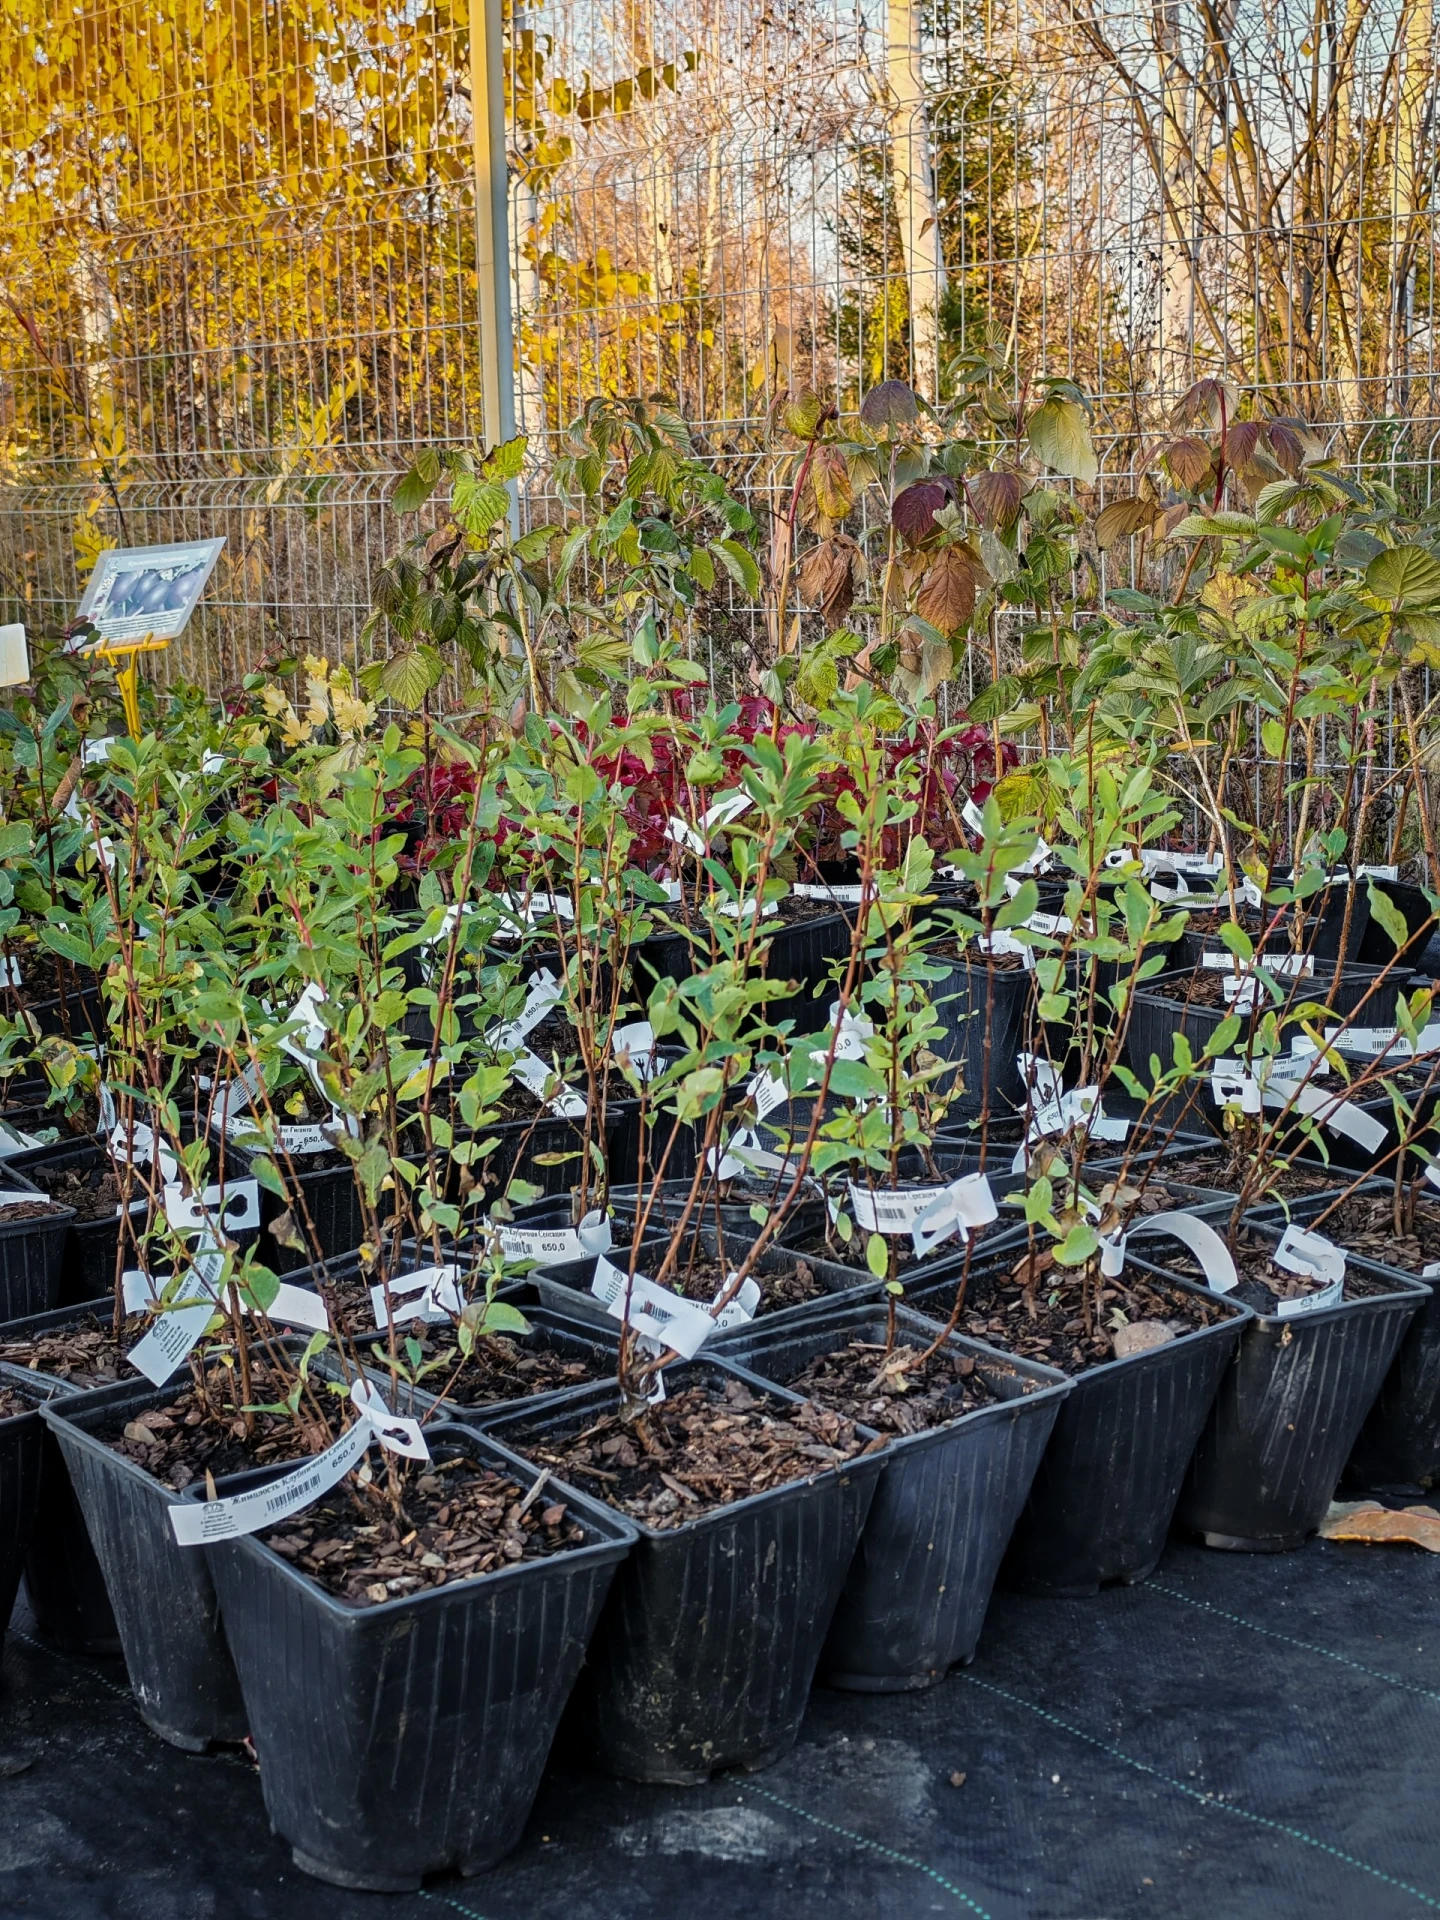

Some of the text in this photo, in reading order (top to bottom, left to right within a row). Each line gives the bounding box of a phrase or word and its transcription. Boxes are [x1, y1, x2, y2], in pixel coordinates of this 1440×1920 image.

[541, 1242, 566, 1252] 650,0
[331, 1441, 356, 1468] 650,0
[281, 1455, 328, 1487] Клубничная
